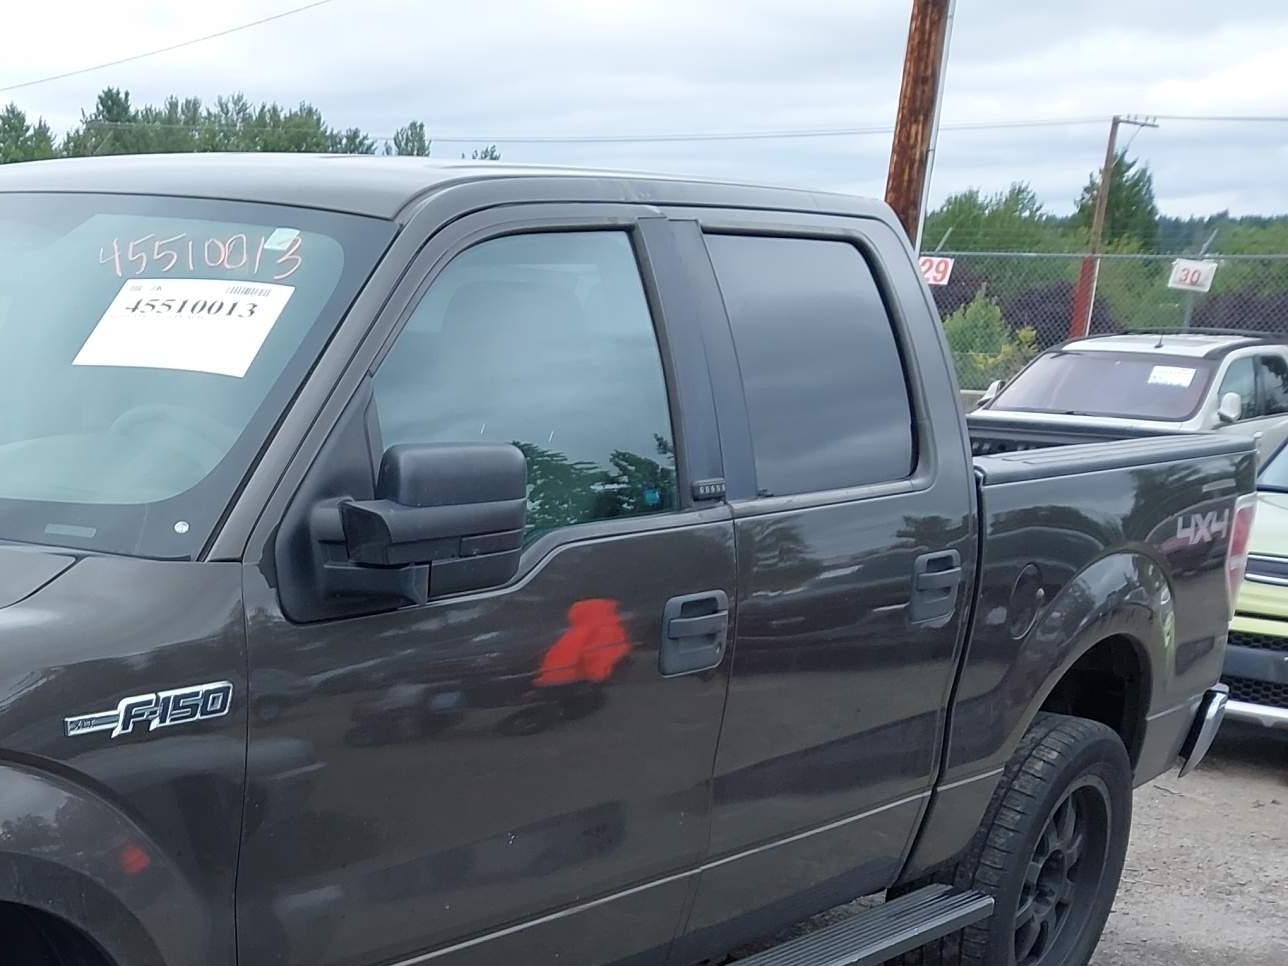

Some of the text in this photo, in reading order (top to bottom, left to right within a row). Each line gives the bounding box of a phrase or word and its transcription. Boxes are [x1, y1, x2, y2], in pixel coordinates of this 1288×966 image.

[99, 232, 303, 280] 45510013
[920, 258, 949, 282] 29
[1179, 268, 1201, 286] 30
[124, 298, 259, 318] 45510013
[116, 683, 233, 736] F-150
